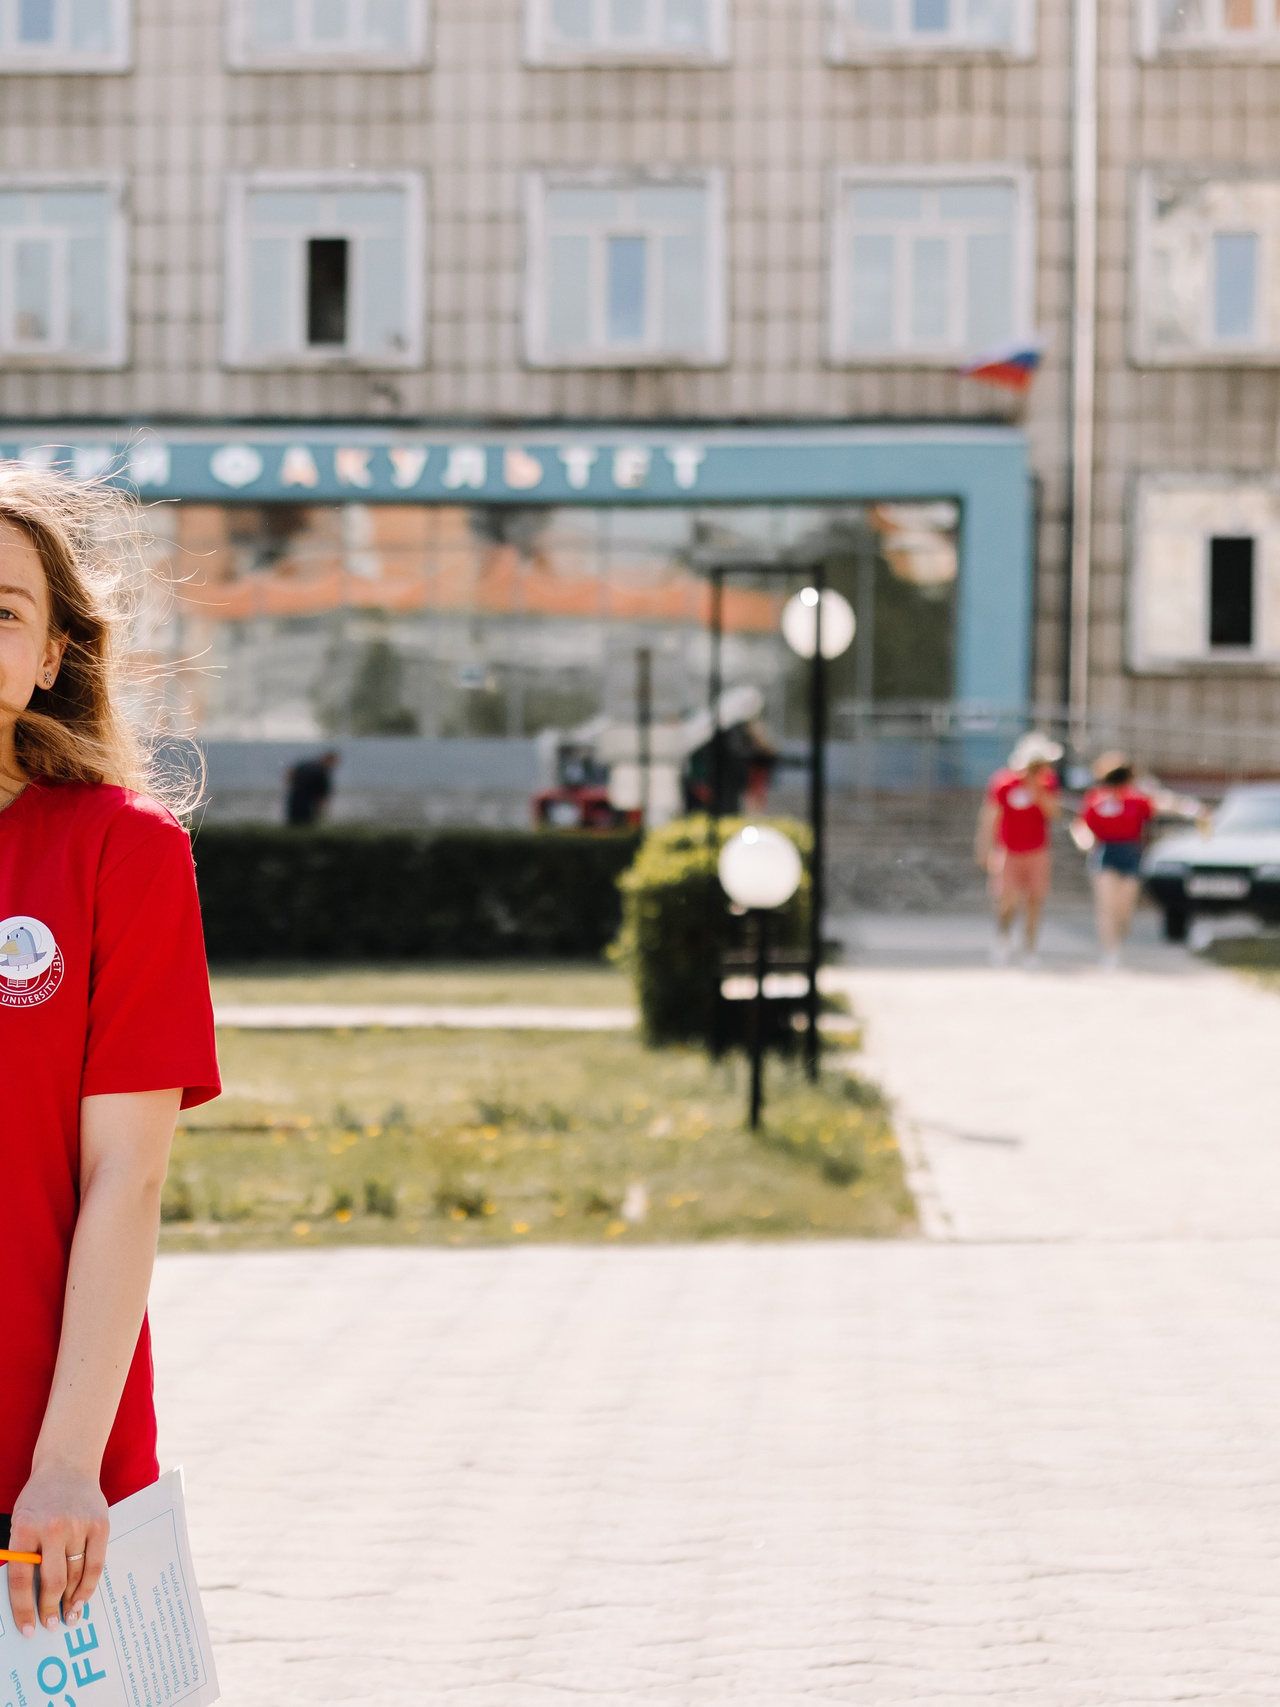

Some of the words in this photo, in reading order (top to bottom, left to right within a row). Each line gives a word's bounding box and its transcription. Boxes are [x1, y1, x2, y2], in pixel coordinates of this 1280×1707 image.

[210, 444, 707, 489] ФАКУЛЬТЕТ
[1, 979, 56, 1005] UNIVERSITY
[102, 1564, 118, 1604] развити
[126, 1571, 144, 1622] шопперов
[159, 1571, 170, 1596] игры
[168, 1561, 181, 1598] группы
[121, 1594, 135, 1630] лекции
[152, 1585, 168, 1632] стритфуд
[176, 1598, 192, 1645] пермские
[112, 1605, 132, 1662] устойчивое
[142, 1631, 155, 1670] одежды
[165, 1597, 191, 1689] Интеллектуальные
[162, 1632, 181, 1694] Правильный
[187, 1646, 199, 1683] Крутые
[128, 1671, 141, 1707] ология
[151, 1671, 163, 1707] Кастом
